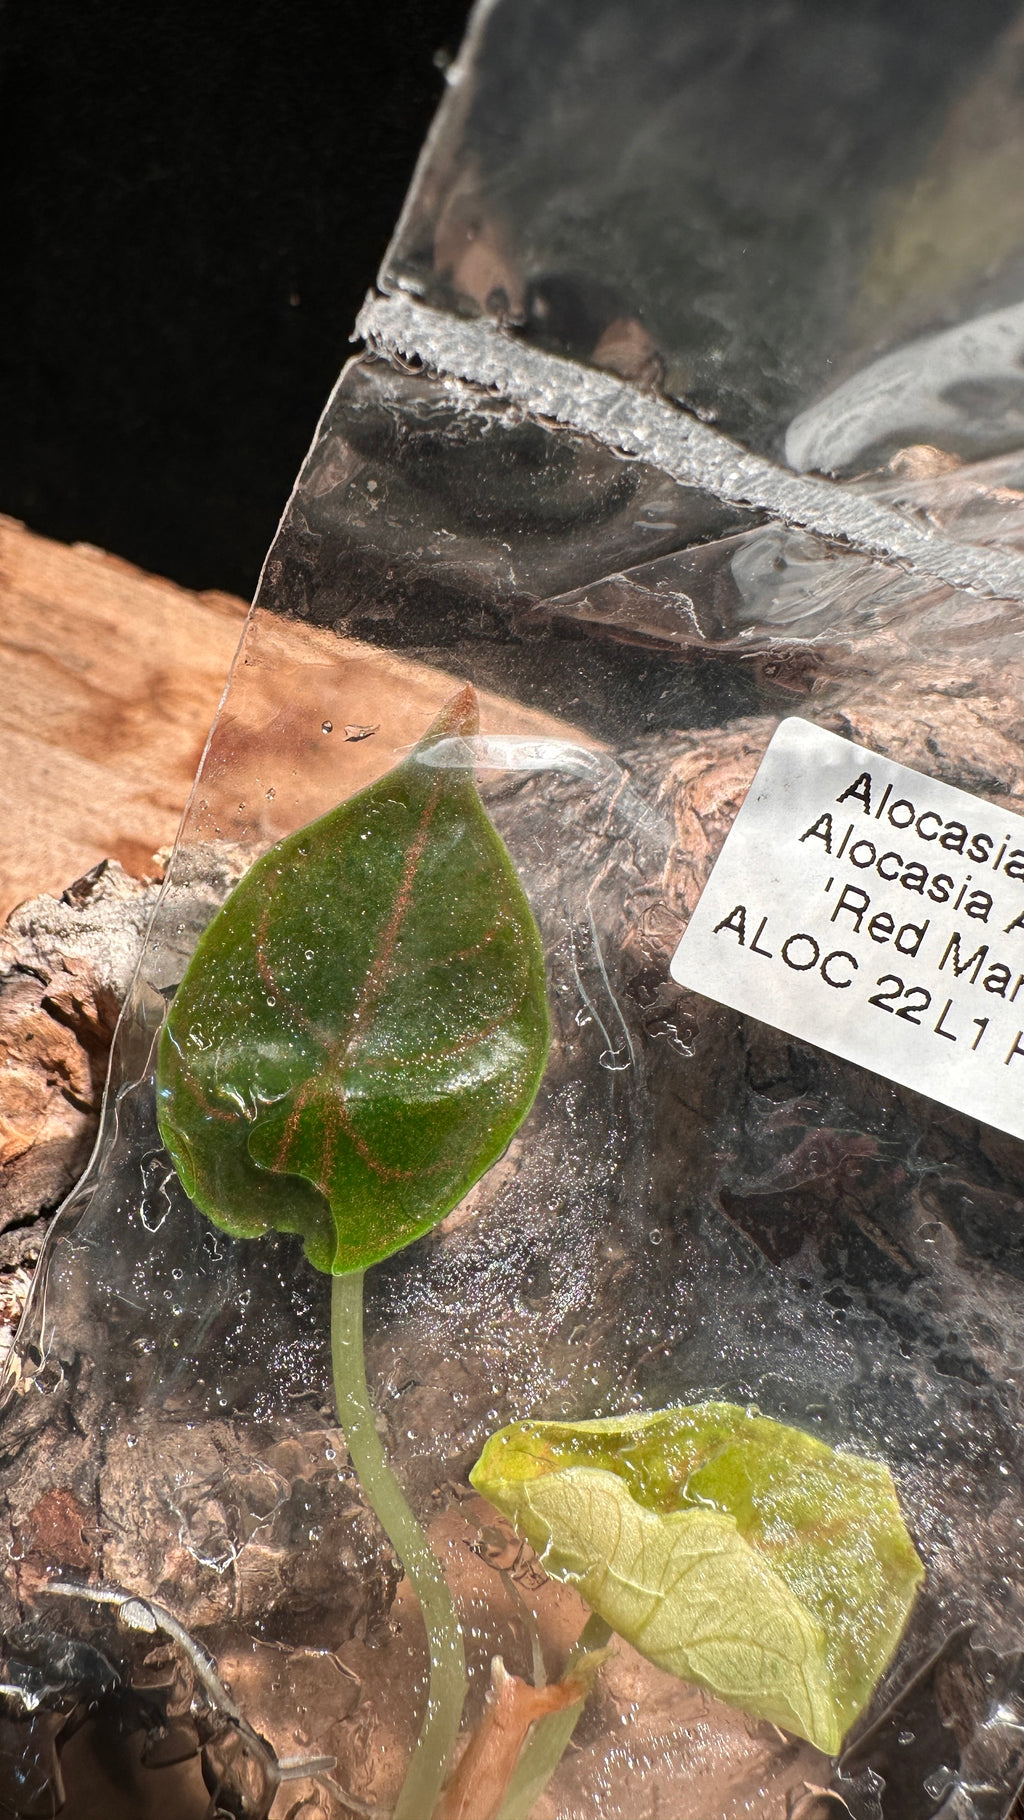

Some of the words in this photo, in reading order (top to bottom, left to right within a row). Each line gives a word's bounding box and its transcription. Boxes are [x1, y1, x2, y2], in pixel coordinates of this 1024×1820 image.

[799, 813, 994, 923] Alocasia
[836, 773, 1024, 882] Alocasia
[824, 878, 929, 958] 'Red
[712, 906, 859, 988] ALOC
[868, 975, 990, 1050] 22L1
